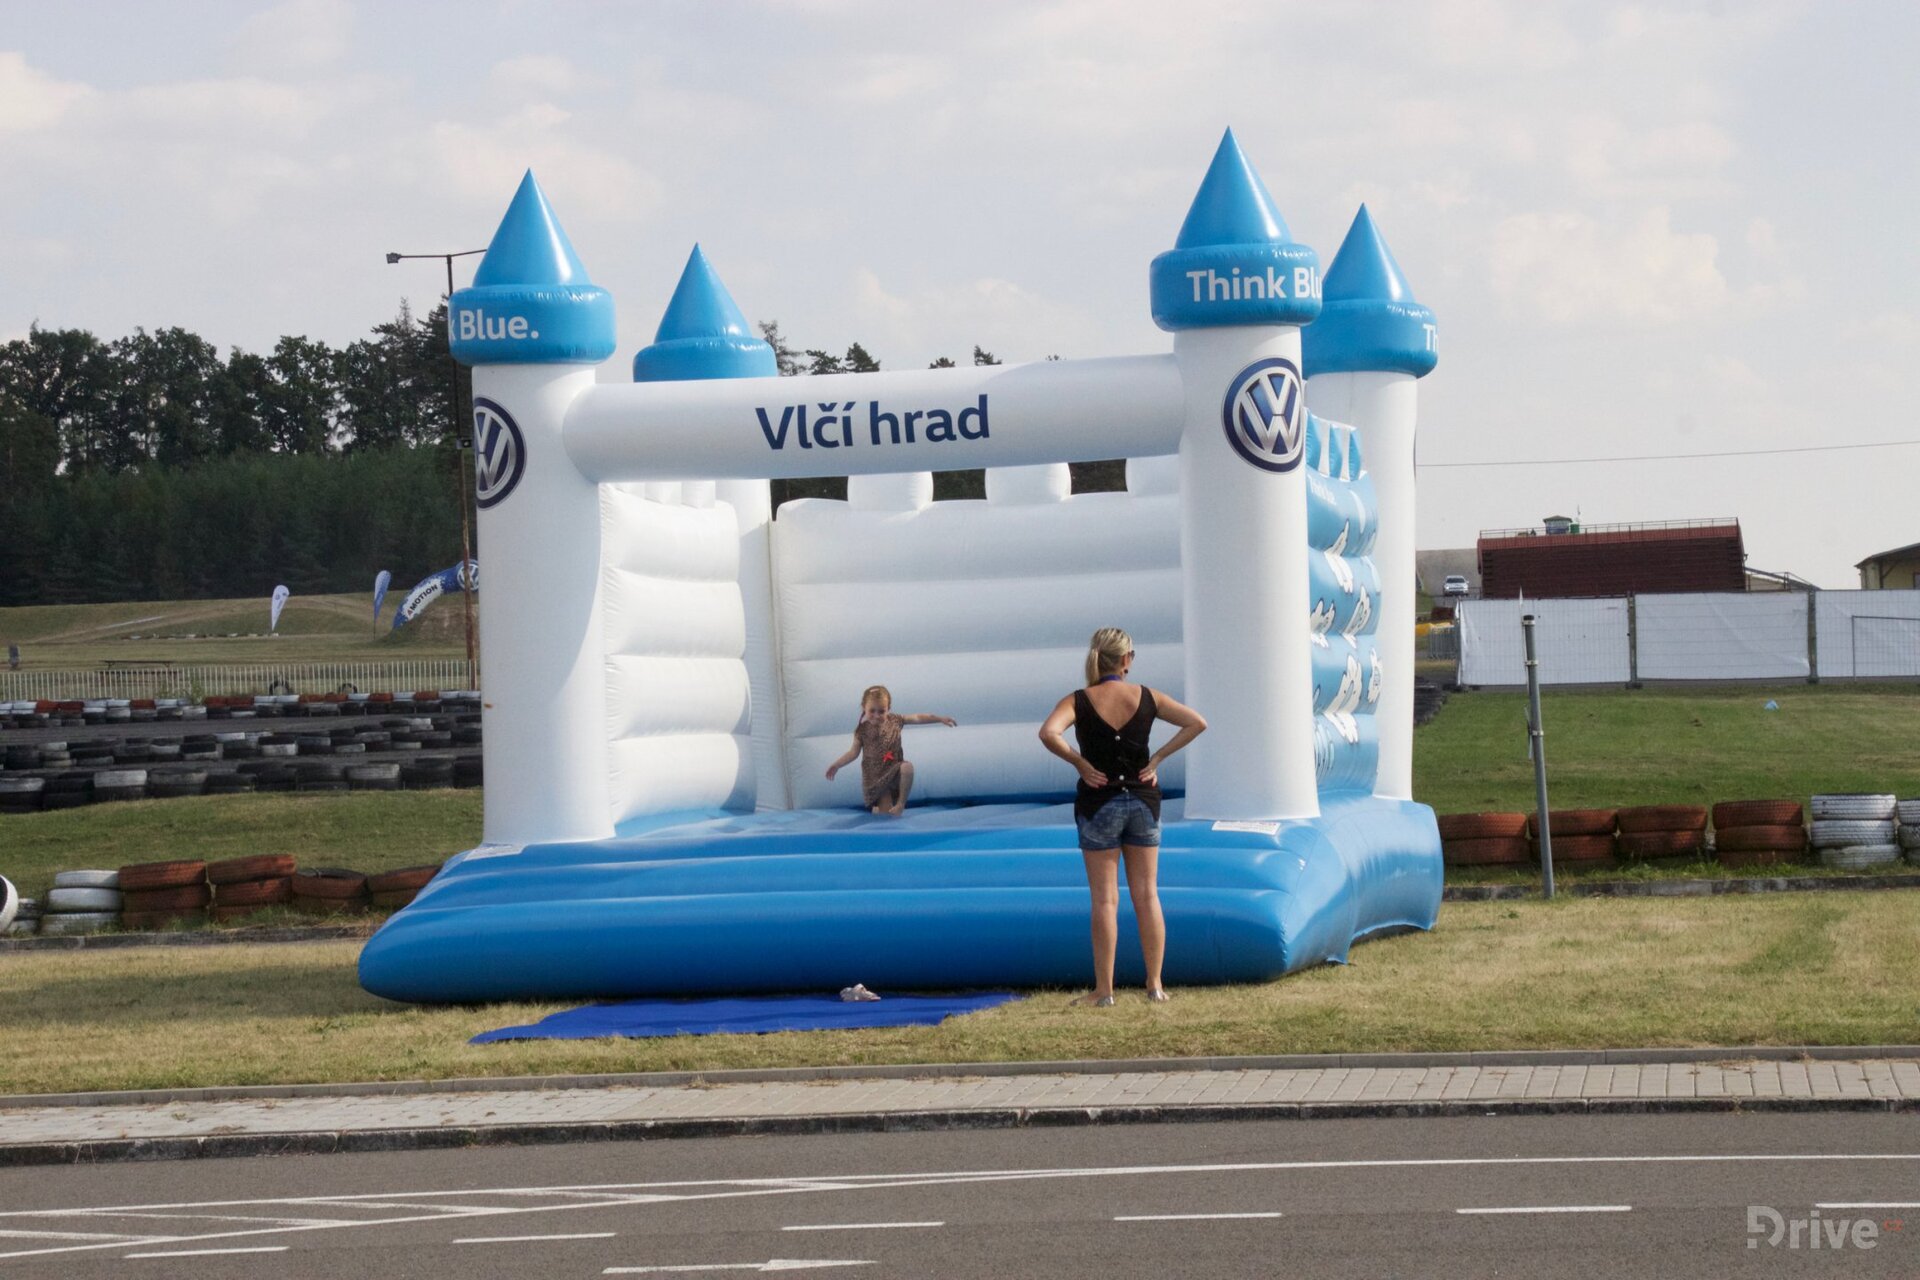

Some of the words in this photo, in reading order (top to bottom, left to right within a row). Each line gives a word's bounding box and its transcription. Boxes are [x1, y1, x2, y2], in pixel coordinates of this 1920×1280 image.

[1186, 267, 1287, 302] Think
[459, 308, 539, 341] Blue.
[755, 401, 856, 450] Vlčí
[870, 394, 990, 446] hrad
